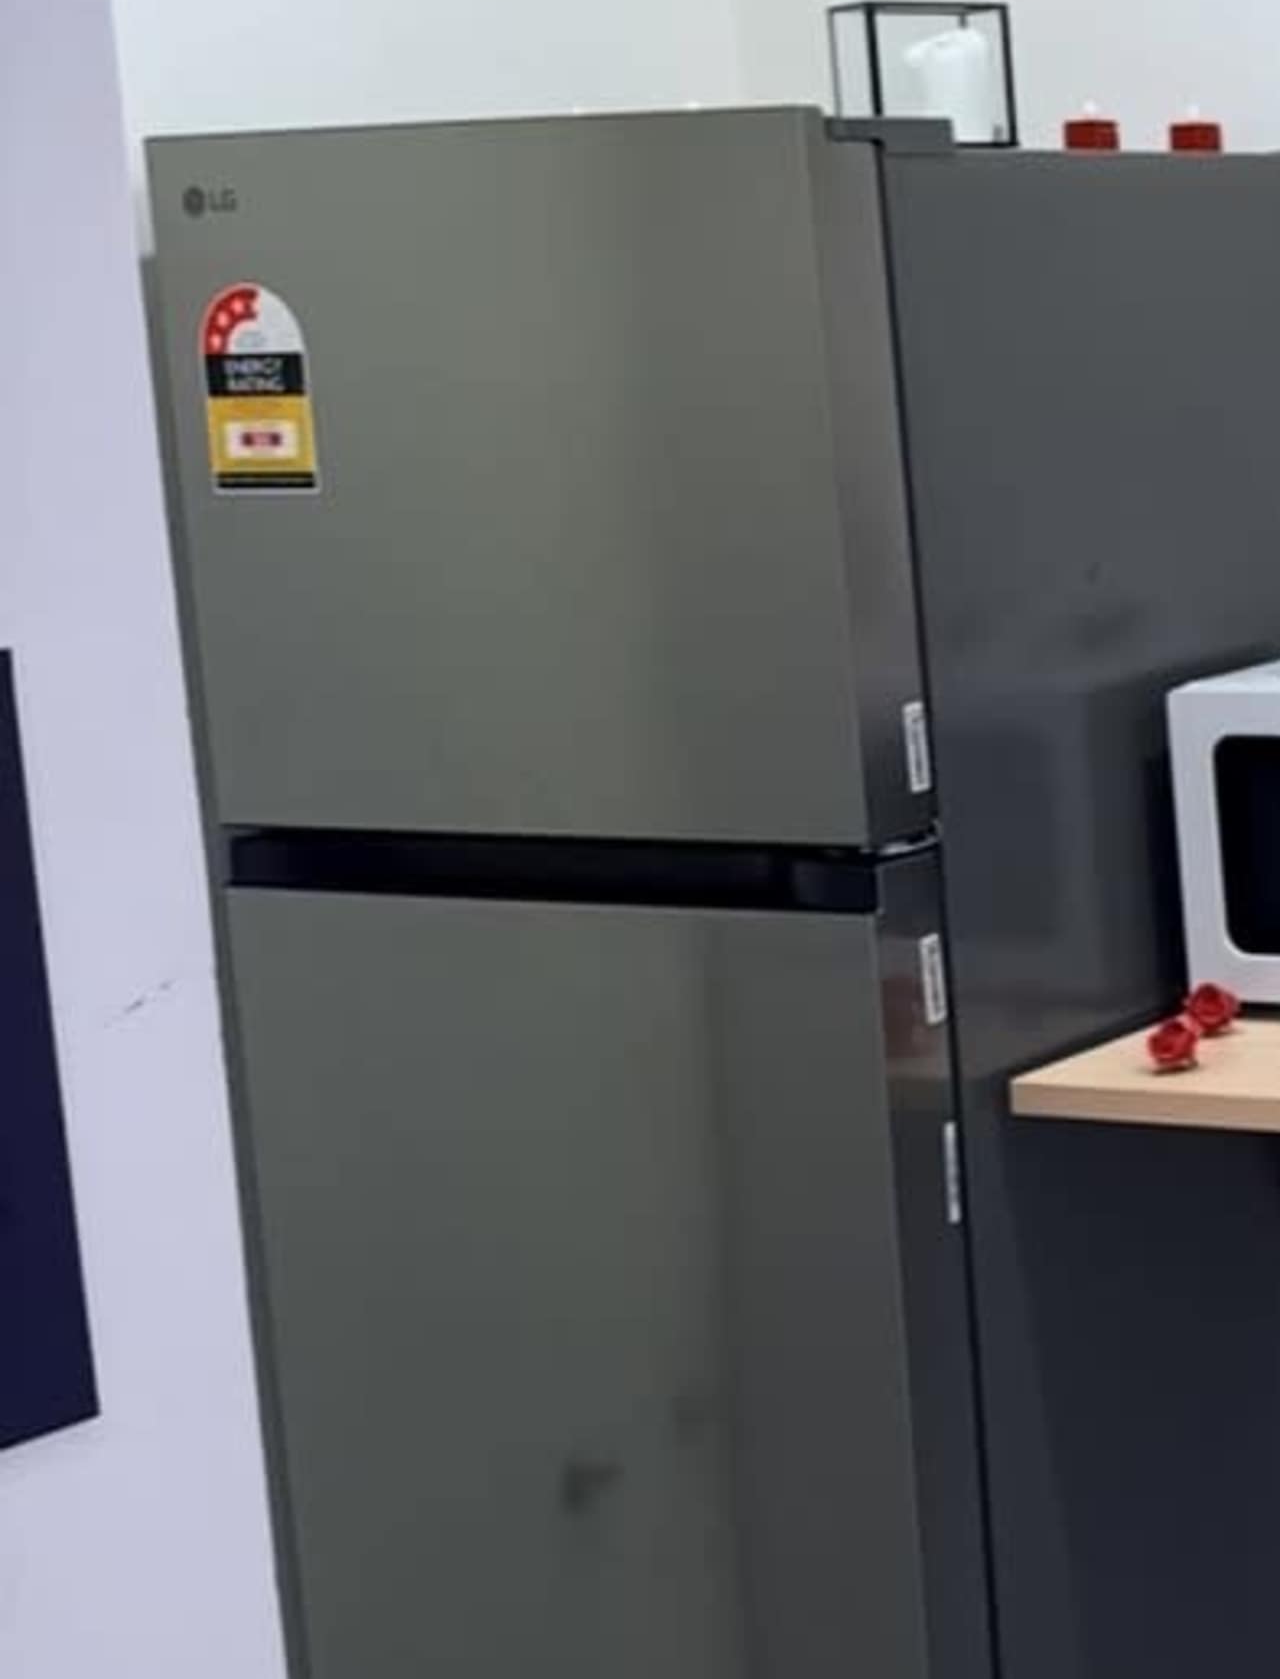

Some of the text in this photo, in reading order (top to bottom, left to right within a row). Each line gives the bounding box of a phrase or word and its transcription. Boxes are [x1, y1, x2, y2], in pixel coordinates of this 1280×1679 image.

[208, 188, 238, 212] LG
[223, 359, 283, 375] ENERGY
[227, 377, 285, 391] RATING
